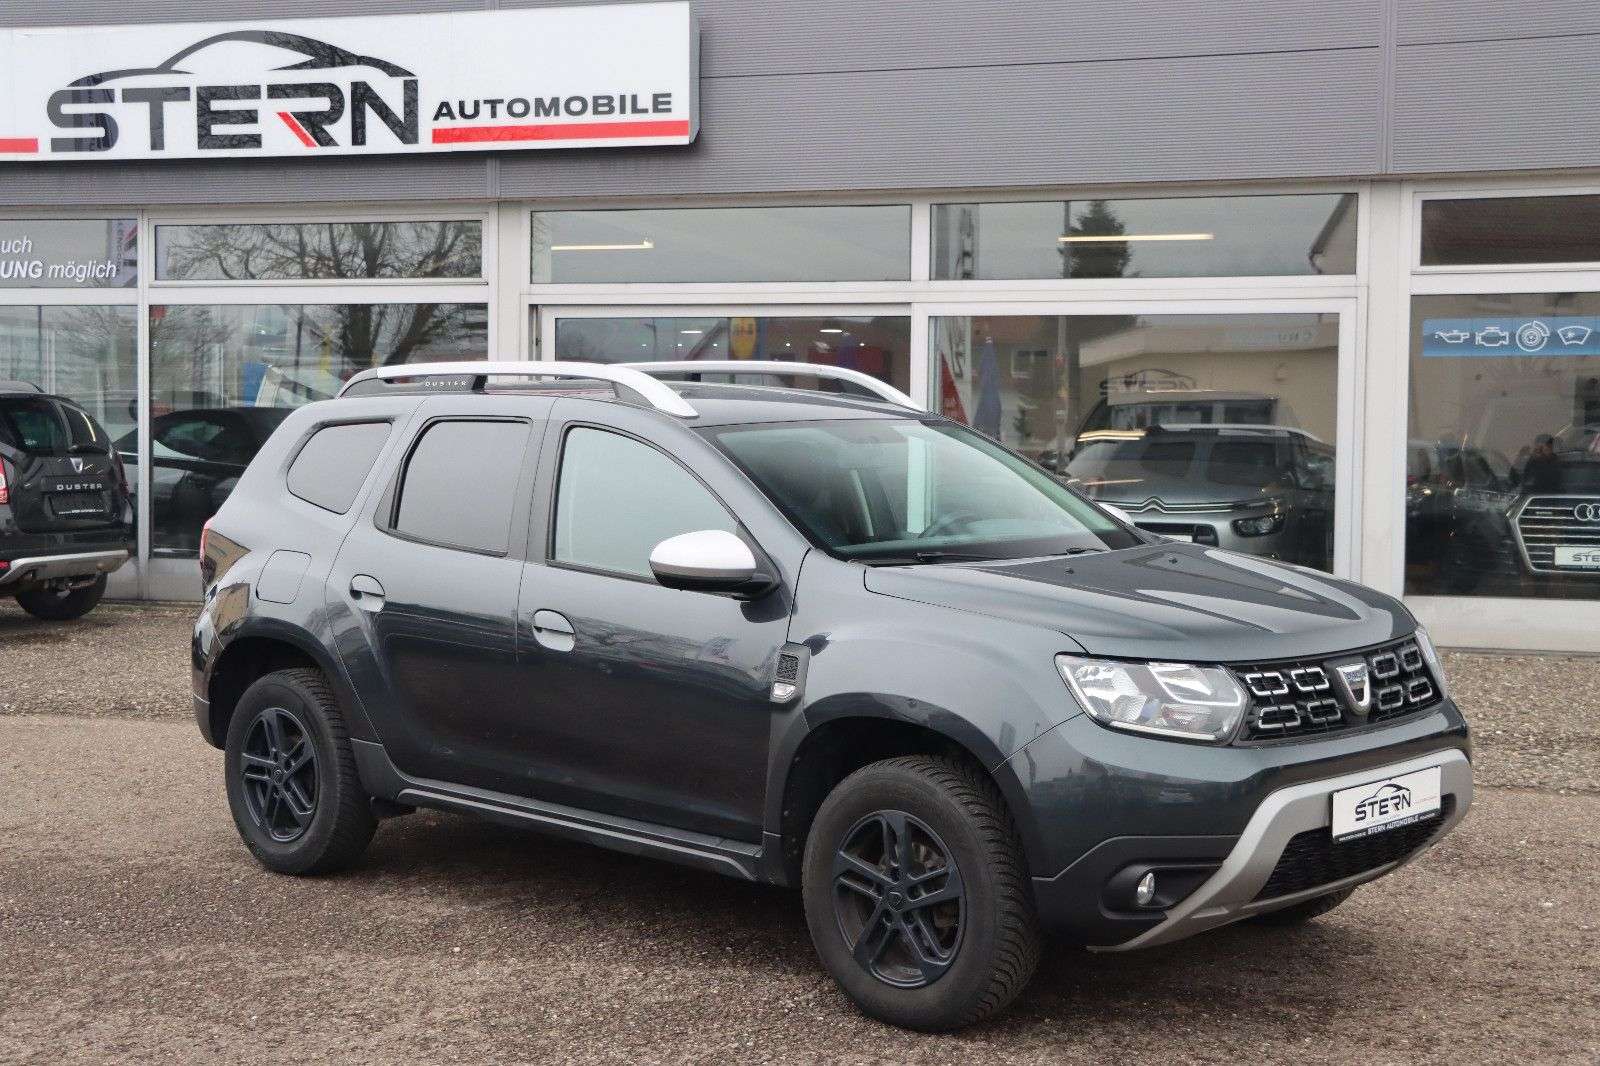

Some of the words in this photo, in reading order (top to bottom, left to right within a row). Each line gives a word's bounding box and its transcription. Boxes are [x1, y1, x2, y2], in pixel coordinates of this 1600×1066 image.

[46, 79, 419, 153] STERN
[432, 92, 674, 122] AUTOMOBILE
[0, 259, 43, 280] UNG
[48, 259, 118, 283] möglich
[1355, 790, 1411, 822] STERN
